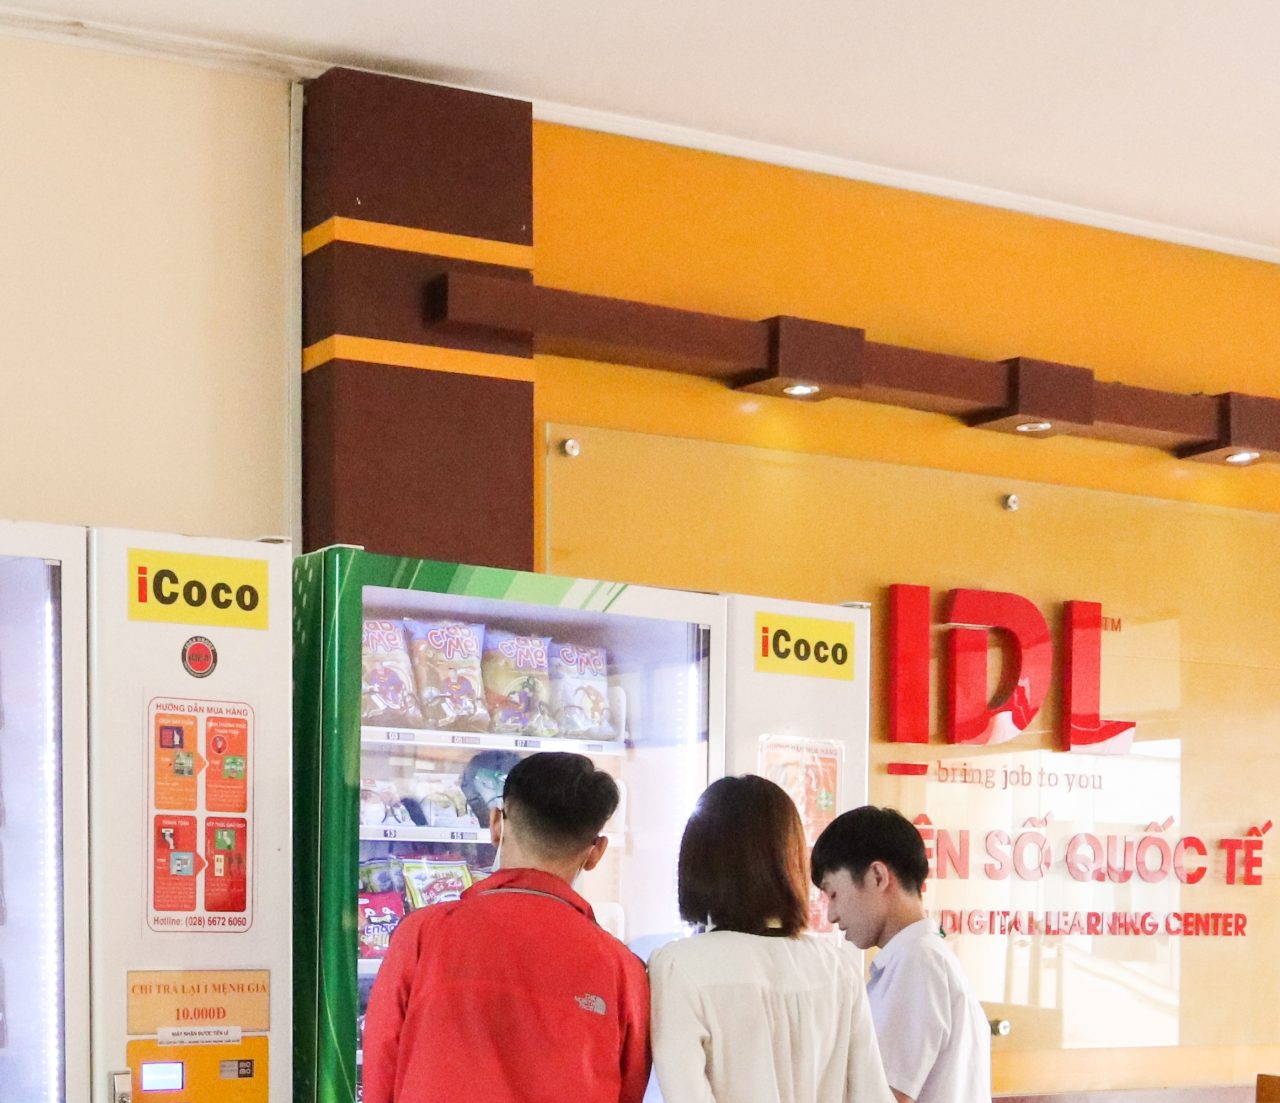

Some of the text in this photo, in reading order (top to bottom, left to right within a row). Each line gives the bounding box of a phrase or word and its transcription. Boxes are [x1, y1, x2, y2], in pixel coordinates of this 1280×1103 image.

[137, 566, 259, 611] iCoco
[762, 626, 848, 665] iCoco
[887, 583, 1136, 755] IDL
[937, 761, 1103, 792] bring job to you
[984, 811, 1053, 881] SỐ
[1066, 816, 1207, 884] QUỐC
[1220, 819, 1272, 885] TẾ
[186, 916, 205, 928] (028)
[940, 909, 1248, 936] DIGITAL LEARNING CENTER
